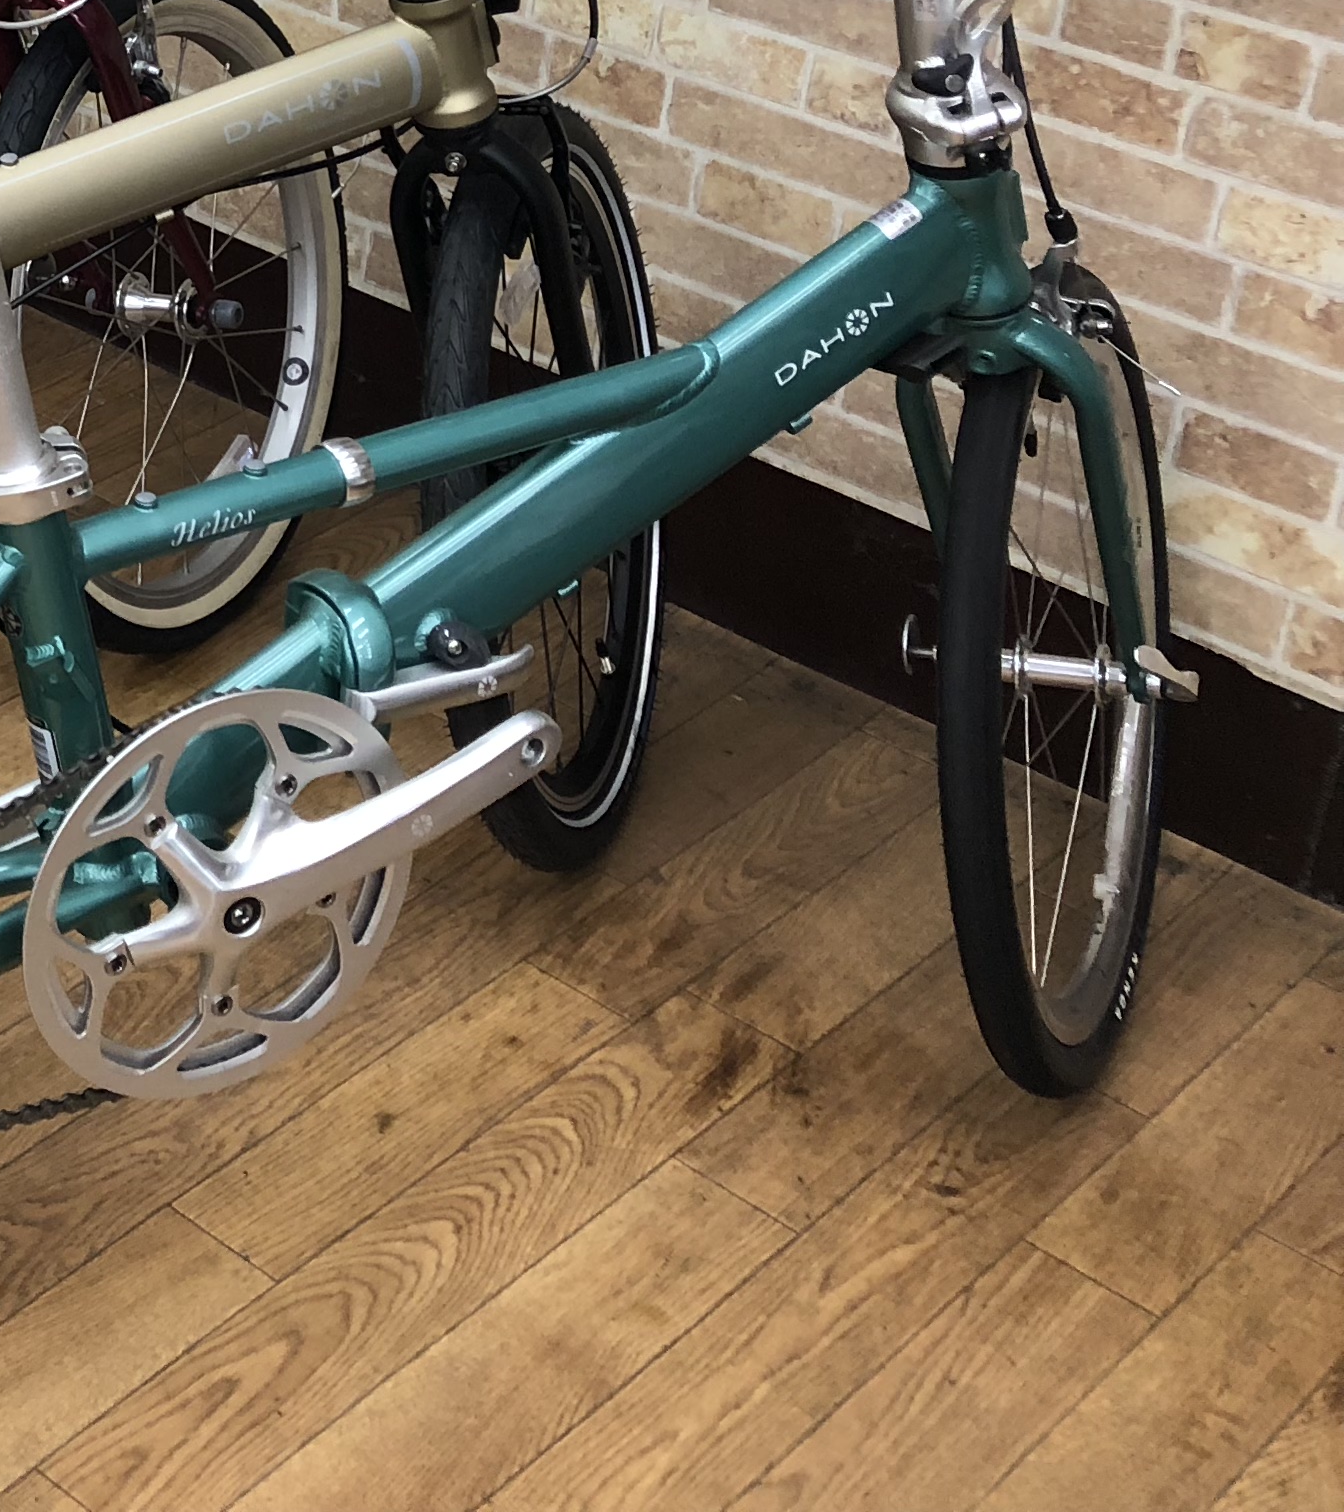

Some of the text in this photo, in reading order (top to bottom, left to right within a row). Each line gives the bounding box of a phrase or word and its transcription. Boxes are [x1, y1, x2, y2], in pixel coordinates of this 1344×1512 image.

[222, 69, 383, 145] DAHON
[775, 291, 895, 387] DAHON
[172, 505, 258, 547] Helios
